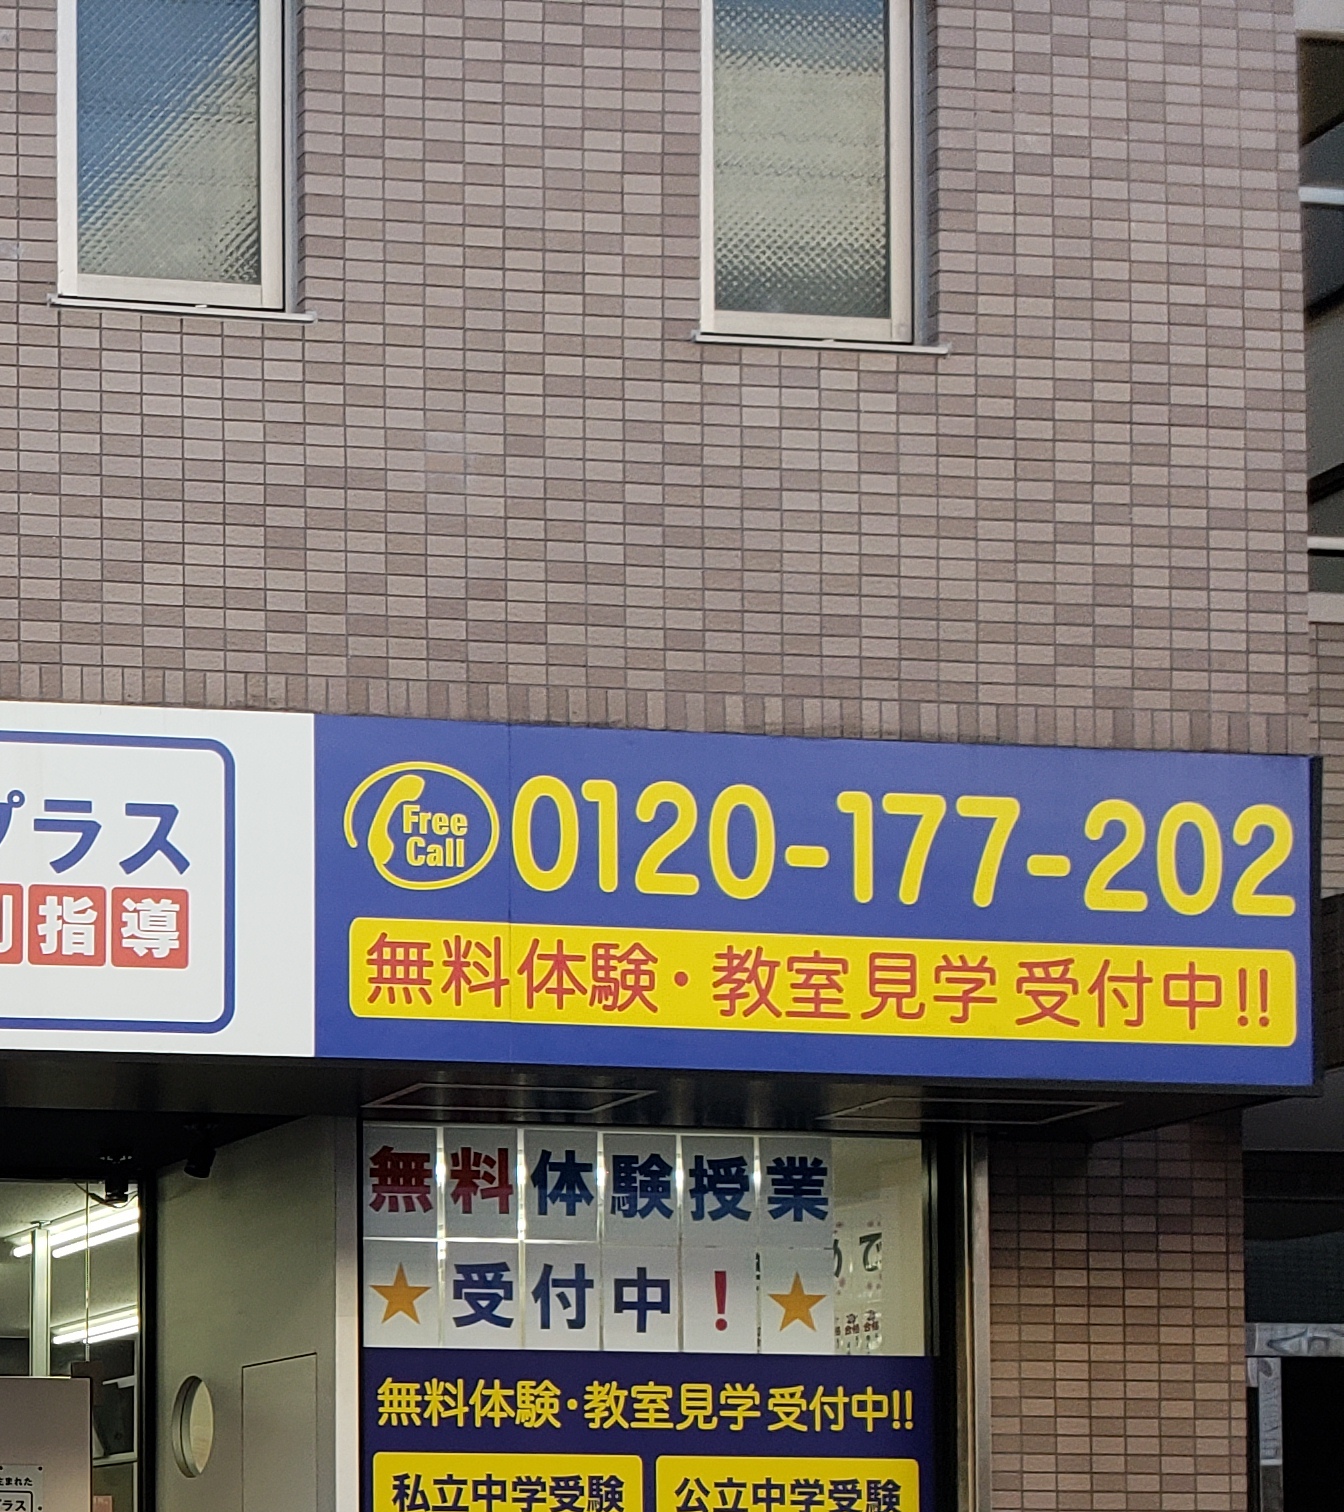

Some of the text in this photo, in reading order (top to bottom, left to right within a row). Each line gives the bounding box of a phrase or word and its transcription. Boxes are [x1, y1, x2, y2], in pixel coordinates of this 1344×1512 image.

[402, 803, 469, 838] Free
[511, 774, 1296, 916] 0120-177-202
[405, 837, 466, 869] Call
[369, 1145, 830, 1222] 無料体験授業
